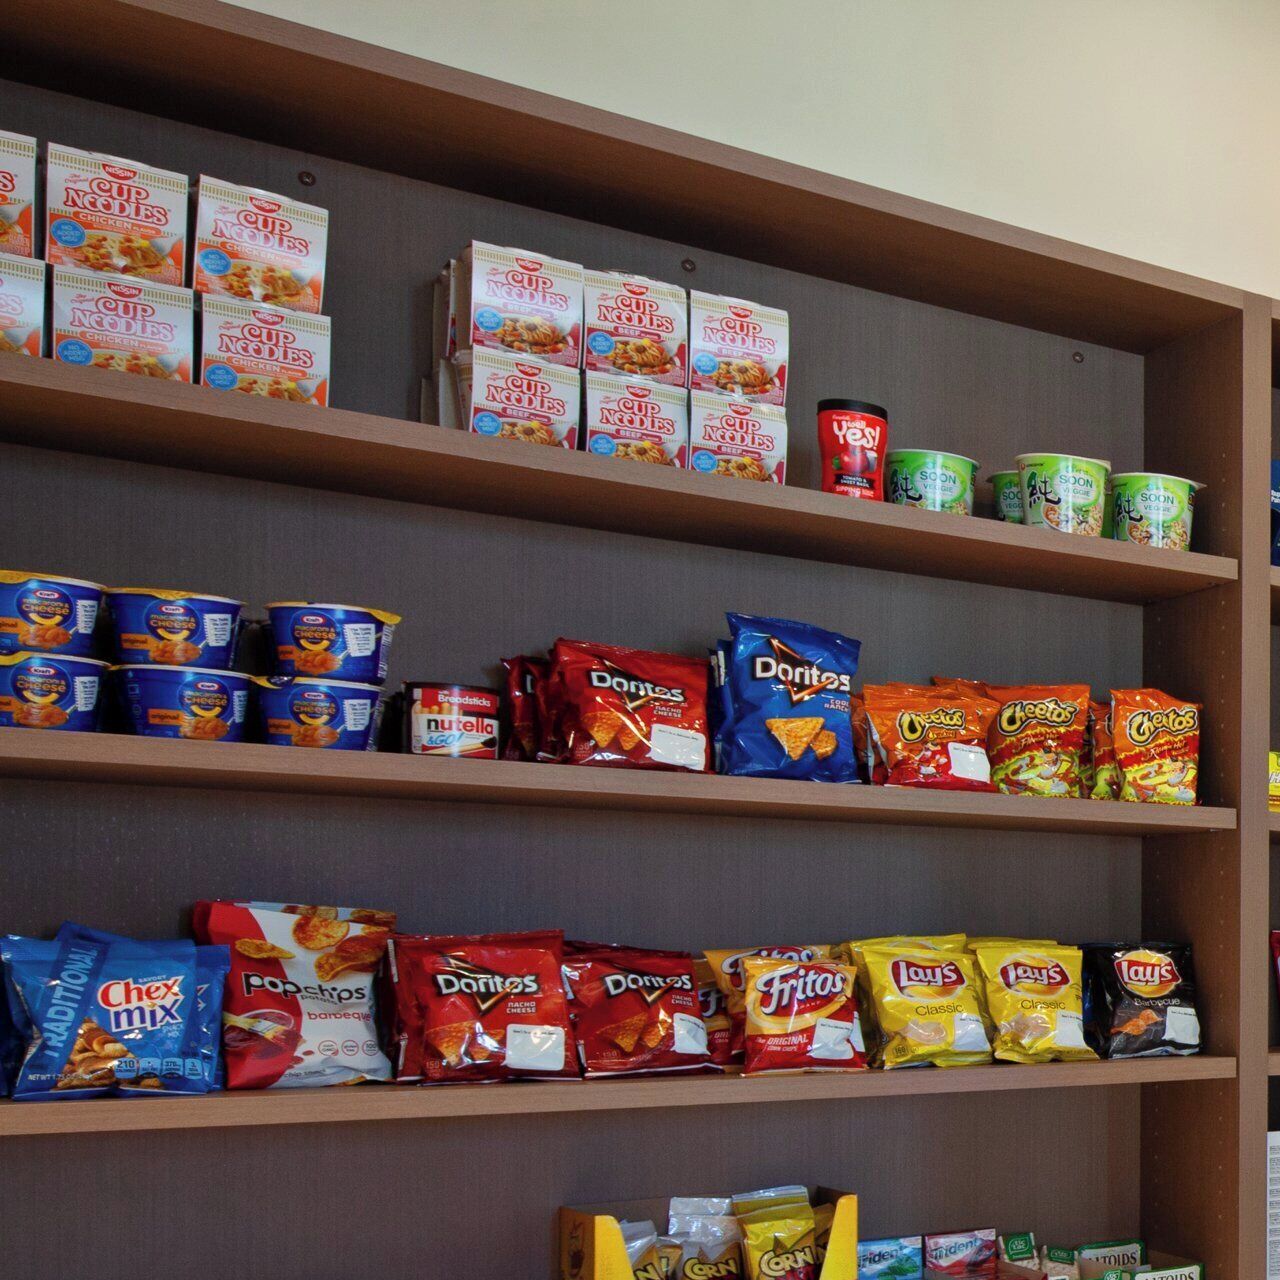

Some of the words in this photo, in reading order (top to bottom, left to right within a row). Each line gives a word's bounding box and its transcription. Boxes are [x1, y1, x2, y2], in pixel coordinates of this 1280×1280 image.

[90, 177, 149, 201] CUP
[65, 186, 169, 226] NOODLES
[78, 213, 131, 229] CHICKEN
[236, 209, 292, 233] CUP
[213, 218, 309, 257] NOODLES
[95, 297, 155, 320] CUP
[598, 304, 674, 333] NOODLES
[70, 309, 175, 343] NOODLES
[241, 325, 295, 347] CUP
[218, 335, 313, 369] NOODLES
[919, 471, 956, 485] SOON
[1059, 474, 1093, 489] SOON
[591, 671, 686, 701] Doritos
[755, 657, 851, 691] Doritos
[438, 694, 491, 707] Breadsticks
[426, 717, 494, 736] nutella
[899, 709, 965, 742] Cheetos
[999, 699, 1079, 734] Cheetos
[1128, 708, 1197, 744] Cheetos
[437, 974, 539, 994] Doritos
[605, 973, 692, 996] Doritos
[899, 961, 957, 986] Lay's
[43, 944, 97, 1057] TRADITIONAL
[98, 976, 184, 1007] Chex
[757, 965, 846, 1012] Fritos
[112, 1002, 182, 1032] mix
[915, 1003, 965, 1016] Classic
[1021, 999, 1066, 1011] Classic
[768, 1034, 810, 1046] ORIGINAL
[759, 1247, 812, 1277] CORN
